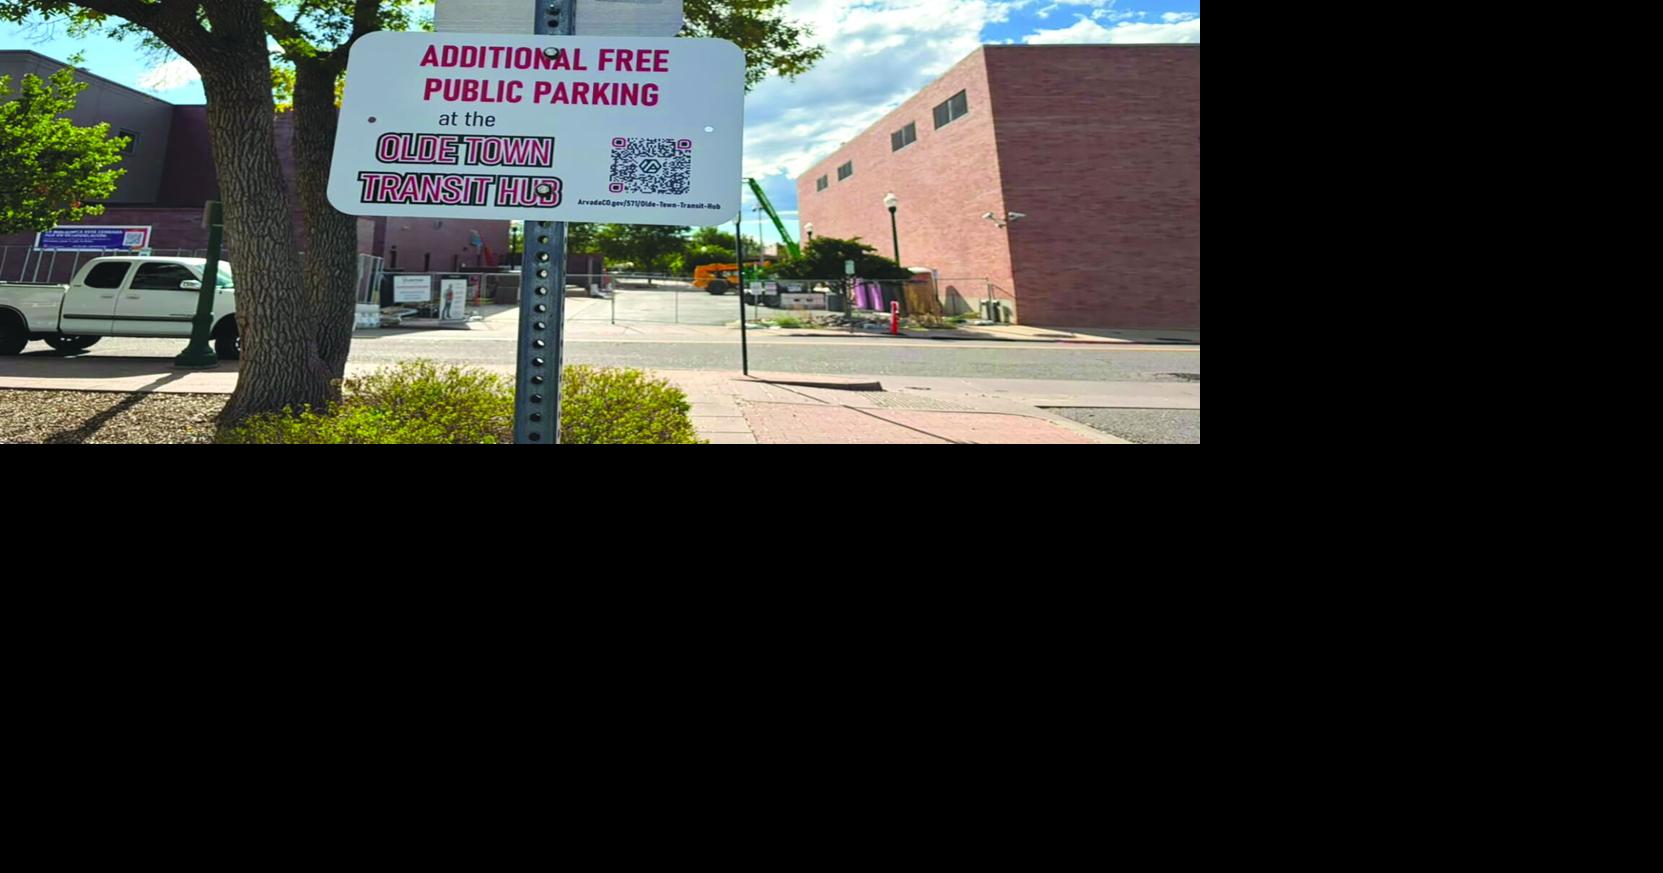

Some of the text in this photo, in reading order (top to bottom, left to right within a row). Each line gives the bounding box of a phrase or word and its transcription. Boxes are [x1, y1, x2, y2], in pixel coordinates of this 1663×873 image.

[420, 44, 670, 73] ADDITIONAL FREE
[423, 78, 660, 107] PUBLIC PARKING
[438, 111, 496, 128] at the
[377, 133, 554, 167] OLDE TOWN
[358, 171, 562, 208] TRANSIT HUB
